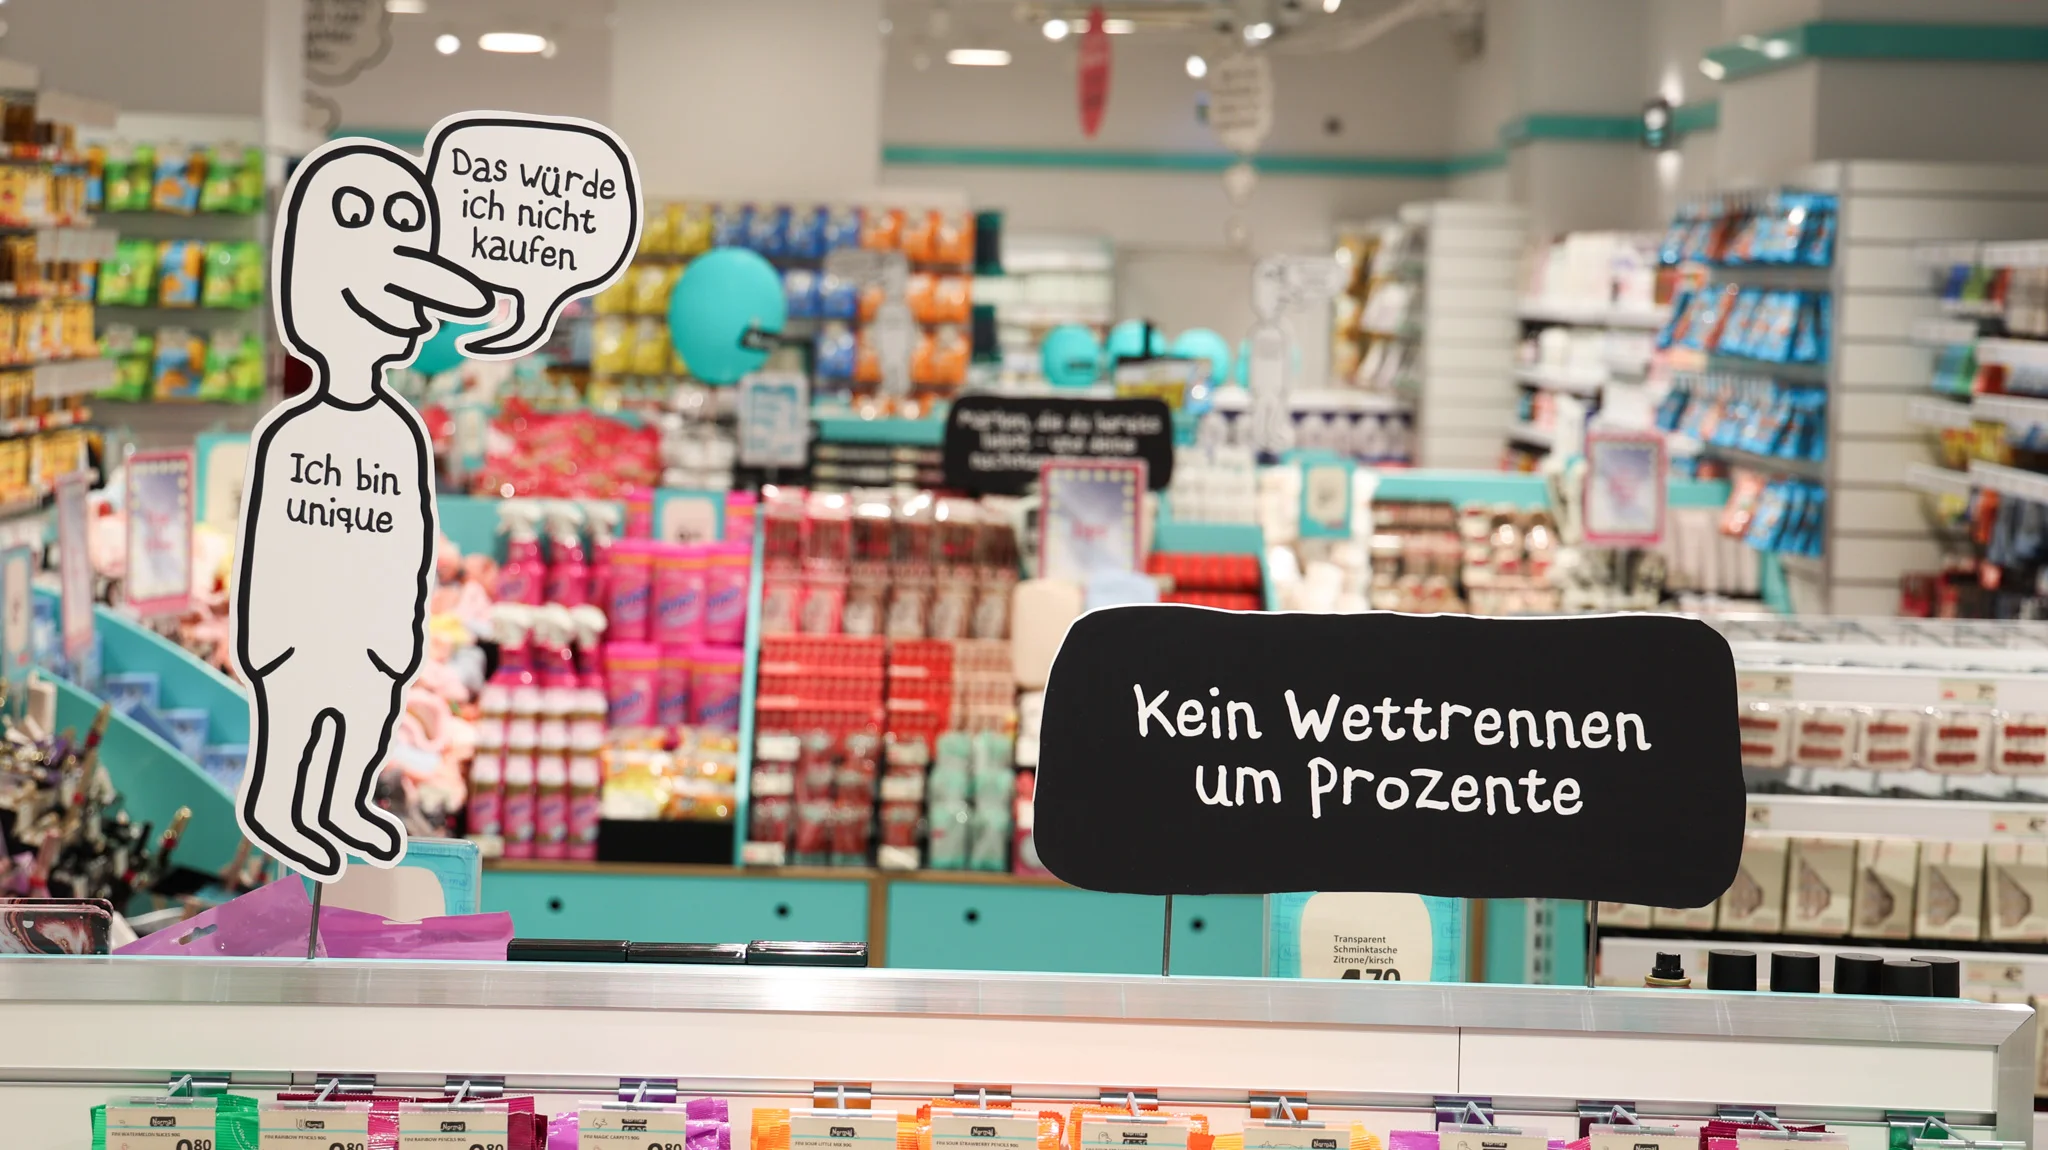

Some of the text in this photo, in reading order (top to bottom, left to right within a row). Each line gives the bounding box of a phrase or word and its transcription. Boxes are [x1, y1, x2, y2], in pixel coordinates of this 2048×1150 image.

[452, 147, 617, 200] Das würde
[462, 188, 597, 234] ich nicht
[471, 225, 578, 271] kaufen
[290, 452, 402, 496] Ich bin
[286, 496, 394, 534] unique
[1133, 683, 1652, 752] Kein Wettrennen
[1195, 756, 1584, 819] um Prozente
[1333, 934, 1387, 944] Transparent
[1333, 945, 1398, 955] Schminktasche
[1333, 955, 1395, 965] Zitrone/kirsch
[151, 1117, 175, 1127] Normal
[441, 1123, 464, 1131] Normal
[831, 1128, 853, 1137] Normal
[972, 1128, 994, 1136] Normal
[1313, 1140, 1336, 1149] Normal
